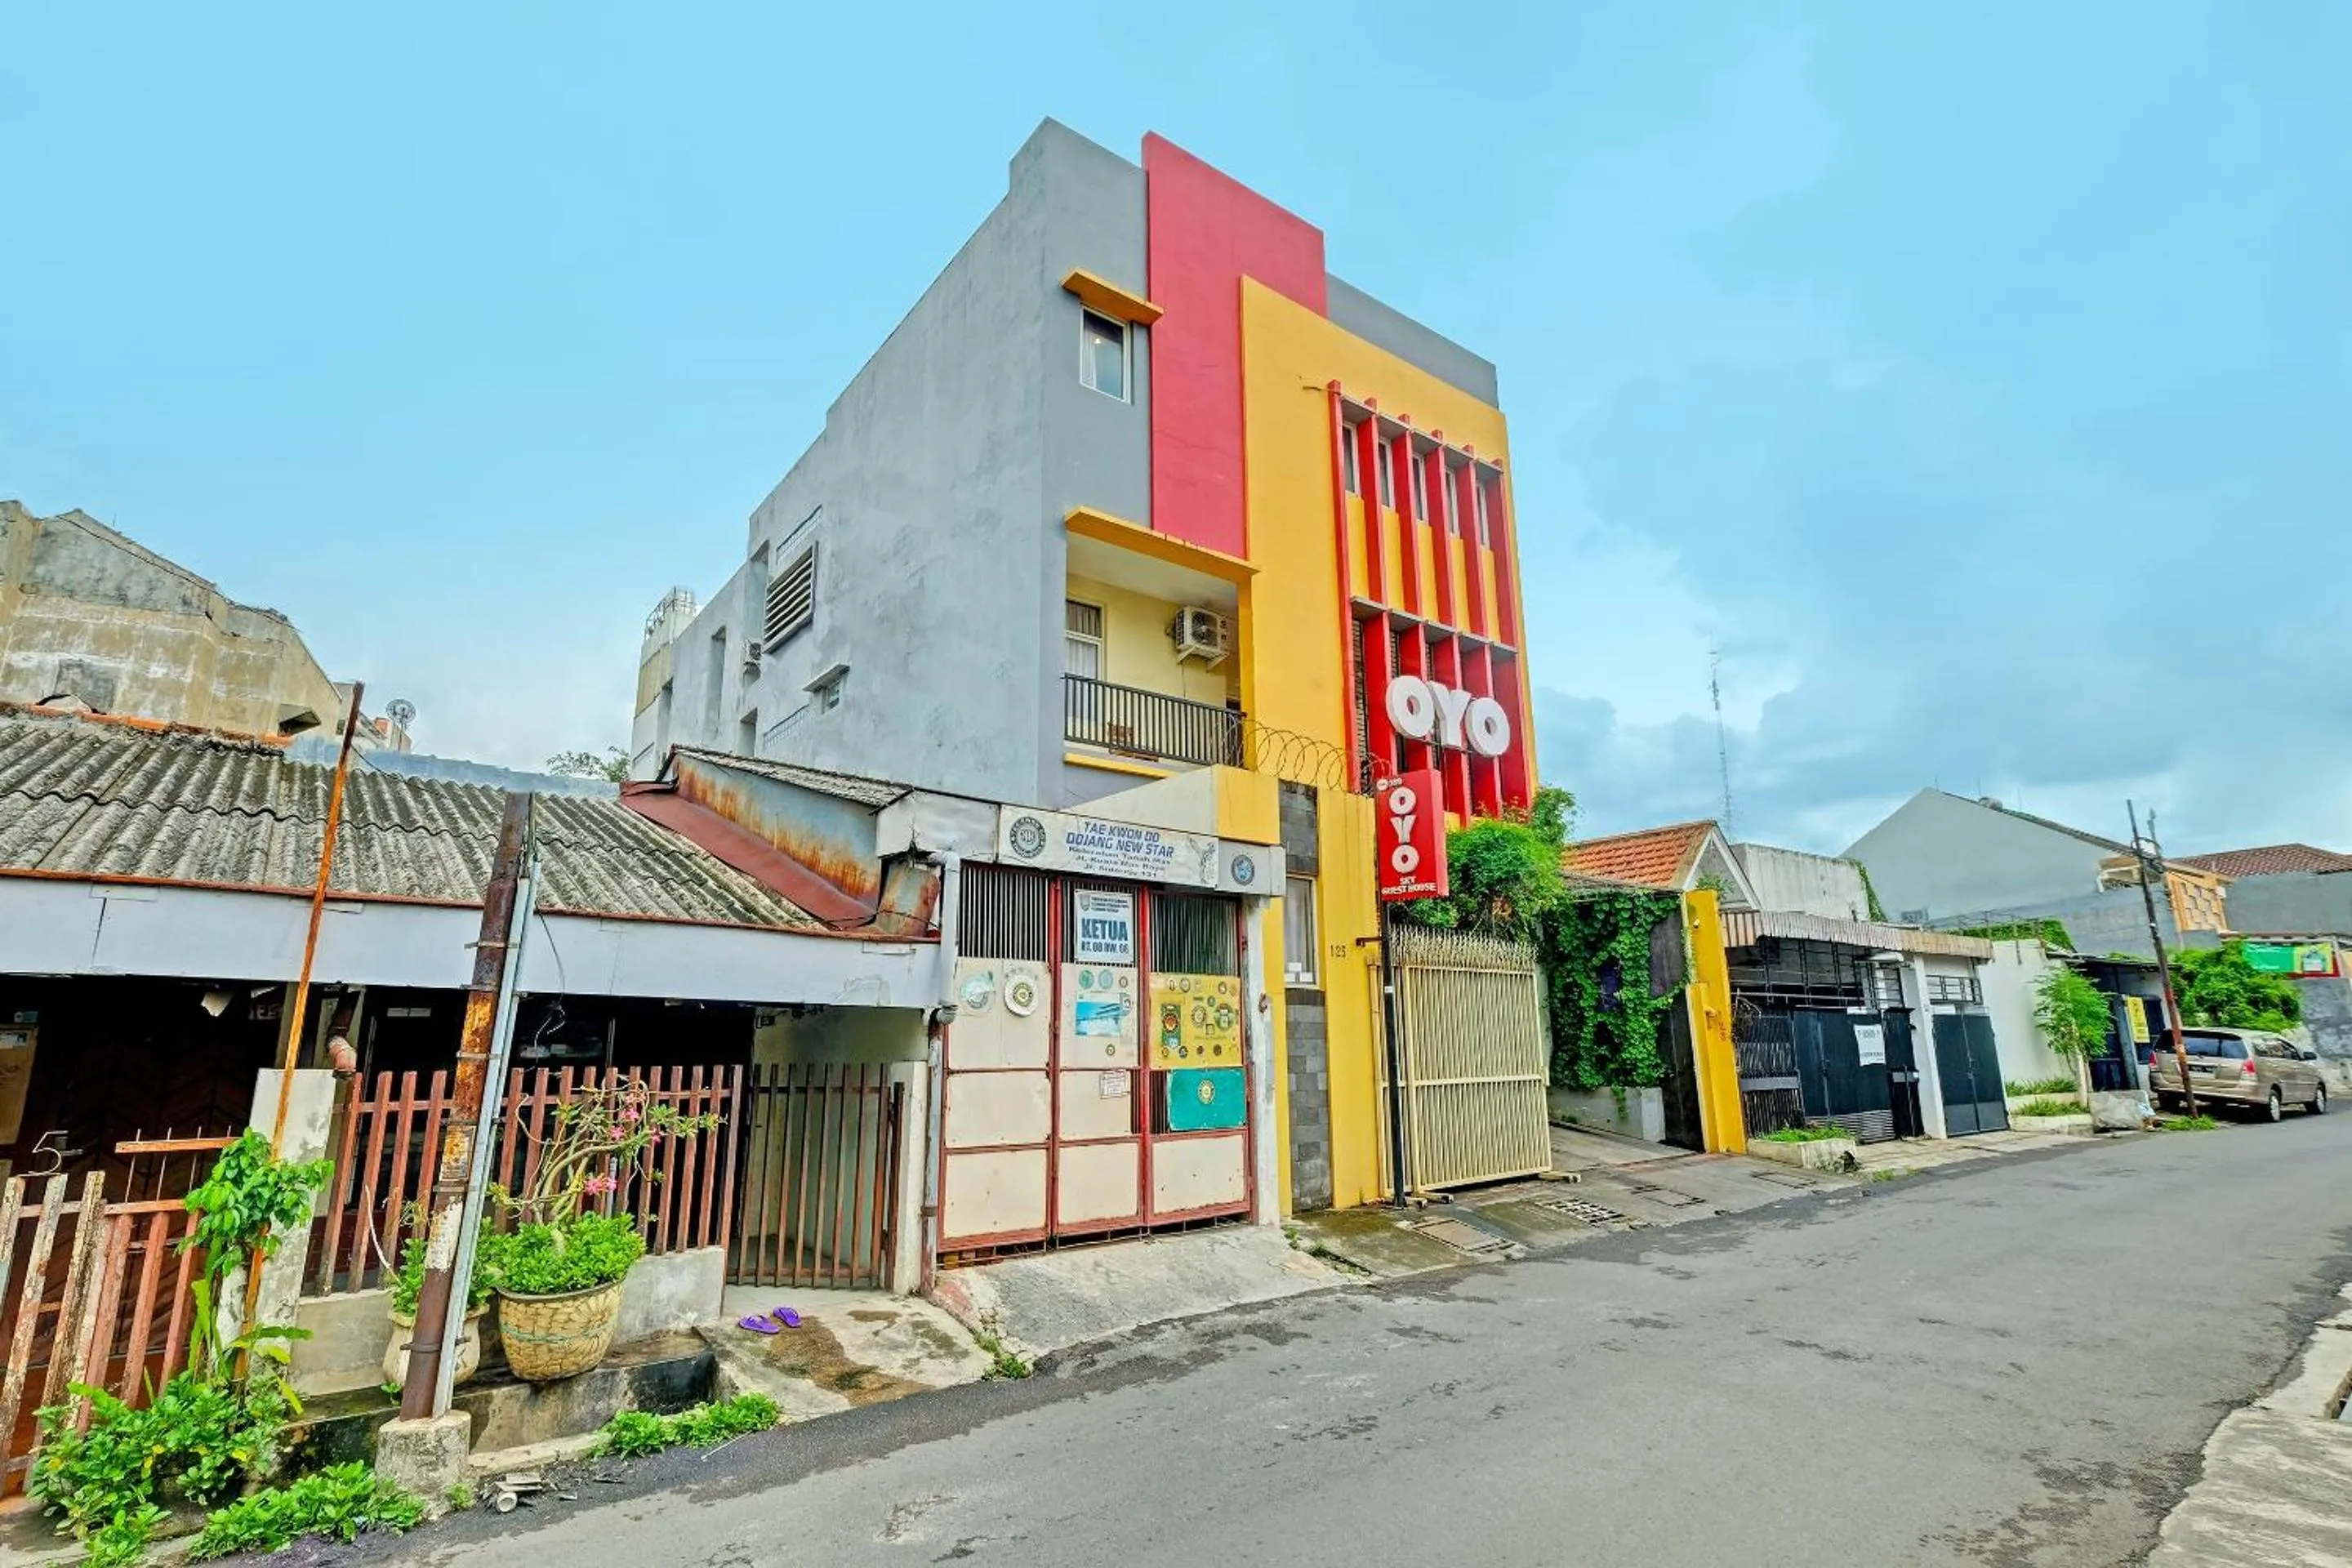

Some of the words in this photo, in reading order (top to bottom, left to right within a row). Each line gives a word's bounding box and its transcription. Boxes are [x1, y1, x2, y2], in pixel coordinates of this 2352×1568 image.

[1386, 675, 1510, 757] OYO
[1085, 822, 1107, 835] TAE
[1108, 826, 1143, 840] KWON
[1144, 831, 1160, 843] DO
[1389, 786, 1420, 874] OYO
[1066, 832, 1113, 849] DOJANG
[1116, 840, 1143, 853] NEW
[1145, 844, 1174, 858] STAR
[1081, 918, 1128, 941] KETUA
